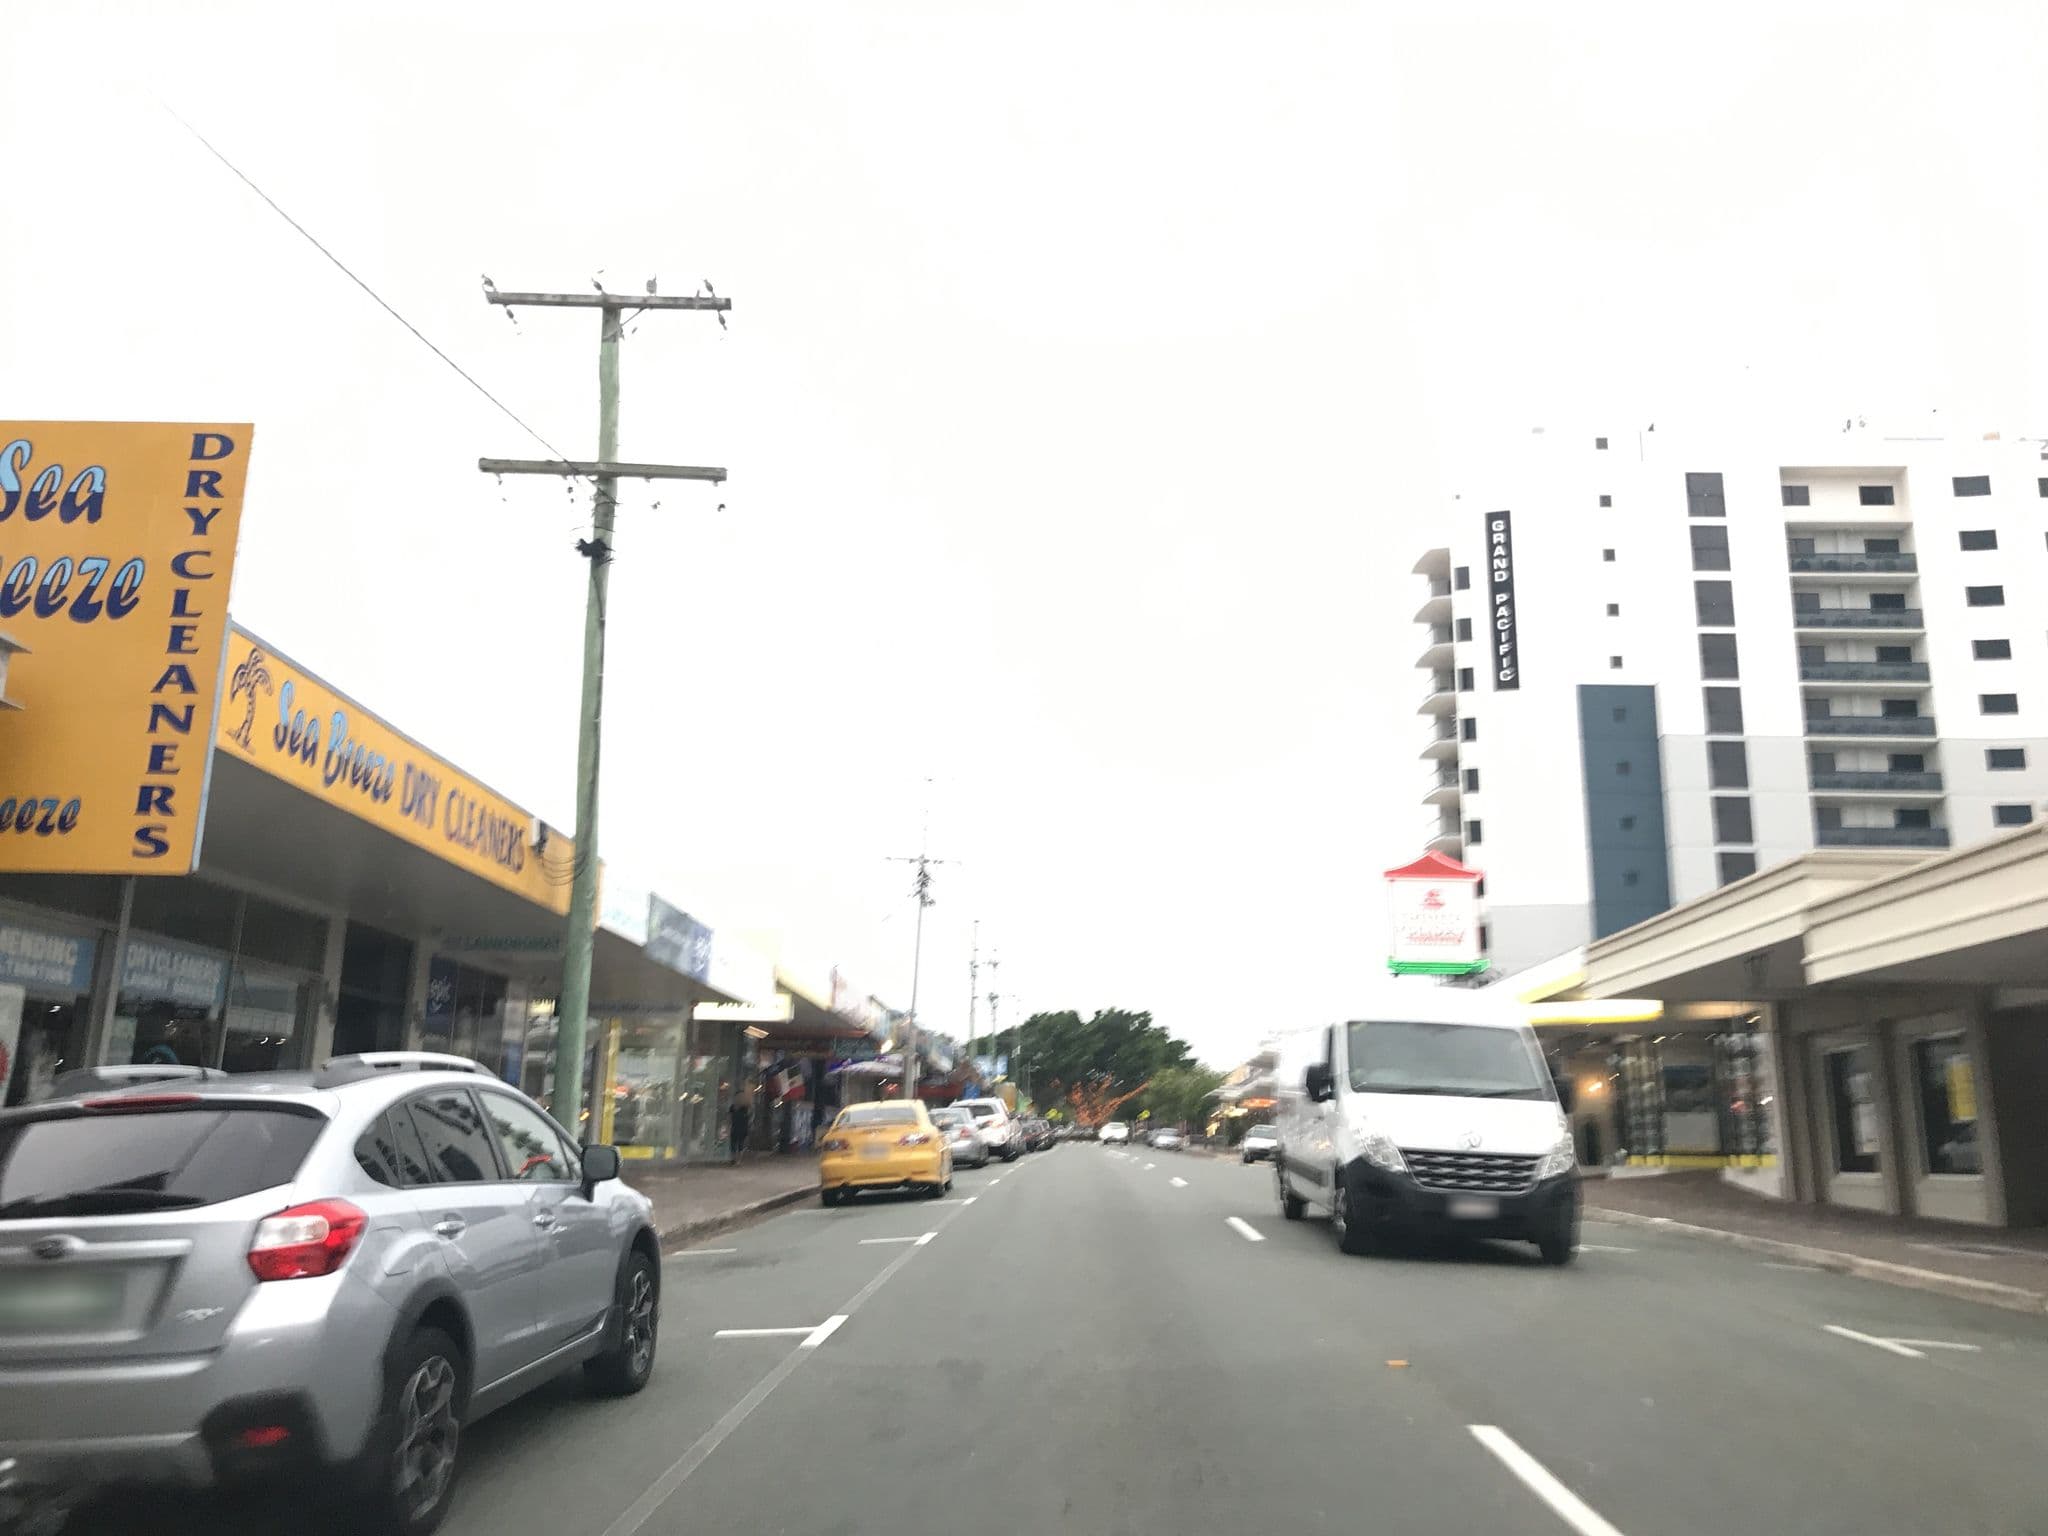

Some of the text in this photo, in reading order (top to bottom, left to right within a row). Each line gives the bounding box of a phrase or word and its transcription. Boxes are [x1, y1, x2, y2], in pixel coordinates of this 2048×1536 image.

[0, 439, 106, 525] Sea
[0, 556, 146, 624] eeze
[132, 432, 235, 858] DRY CLEANERS
[1491, 519, 1514, 682] GRAND PACIFIC
[274, 680, 526, 874] Sea Breeze DRY CLEANERS
